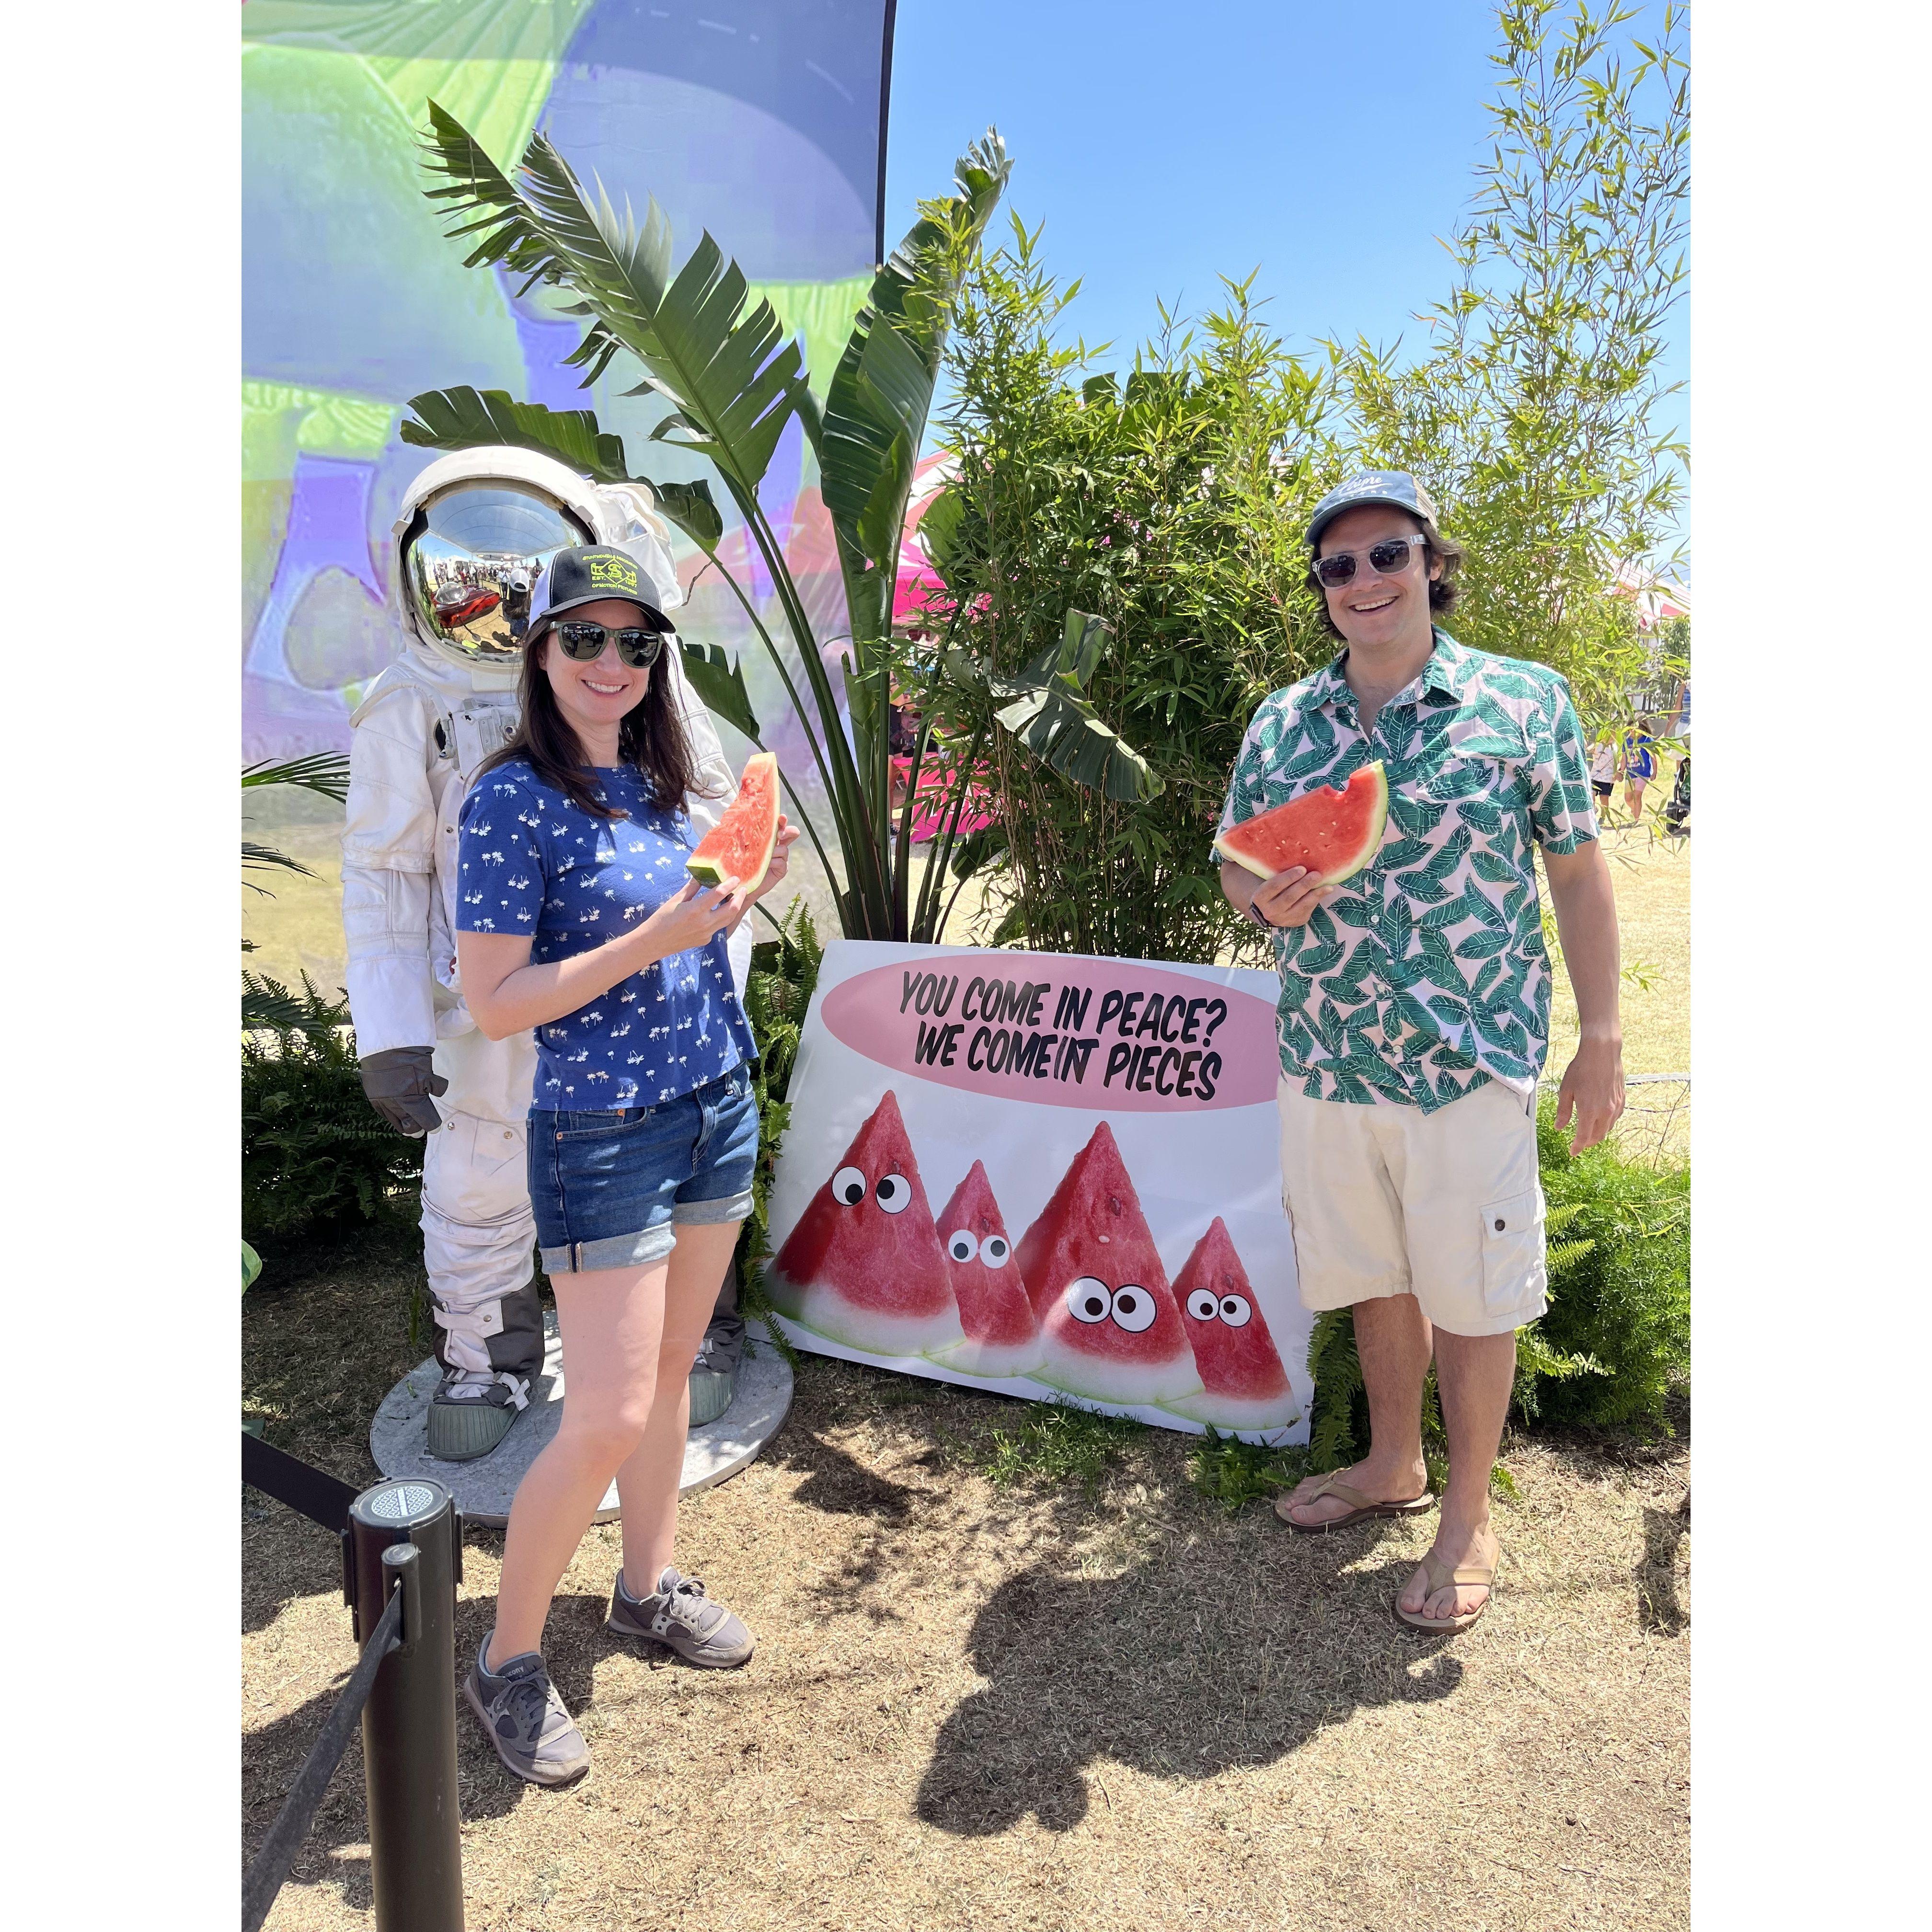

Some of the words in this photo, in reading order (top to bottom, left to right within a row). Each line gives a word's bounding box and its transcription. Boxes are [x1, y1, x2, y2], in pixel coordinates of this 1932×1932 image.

[900, 971, 959, 1017] YOU
[961, 976, 1051, 1026] COME
[1053, 985, 1092, 1032] IN
[1095, 989, 1227, 1047] PEACE?
[915, 1020, 965, 1067] WE
[1103, 1042, 1222, 1101] PIECES
[504, 1666, 524, 1677] ucony
